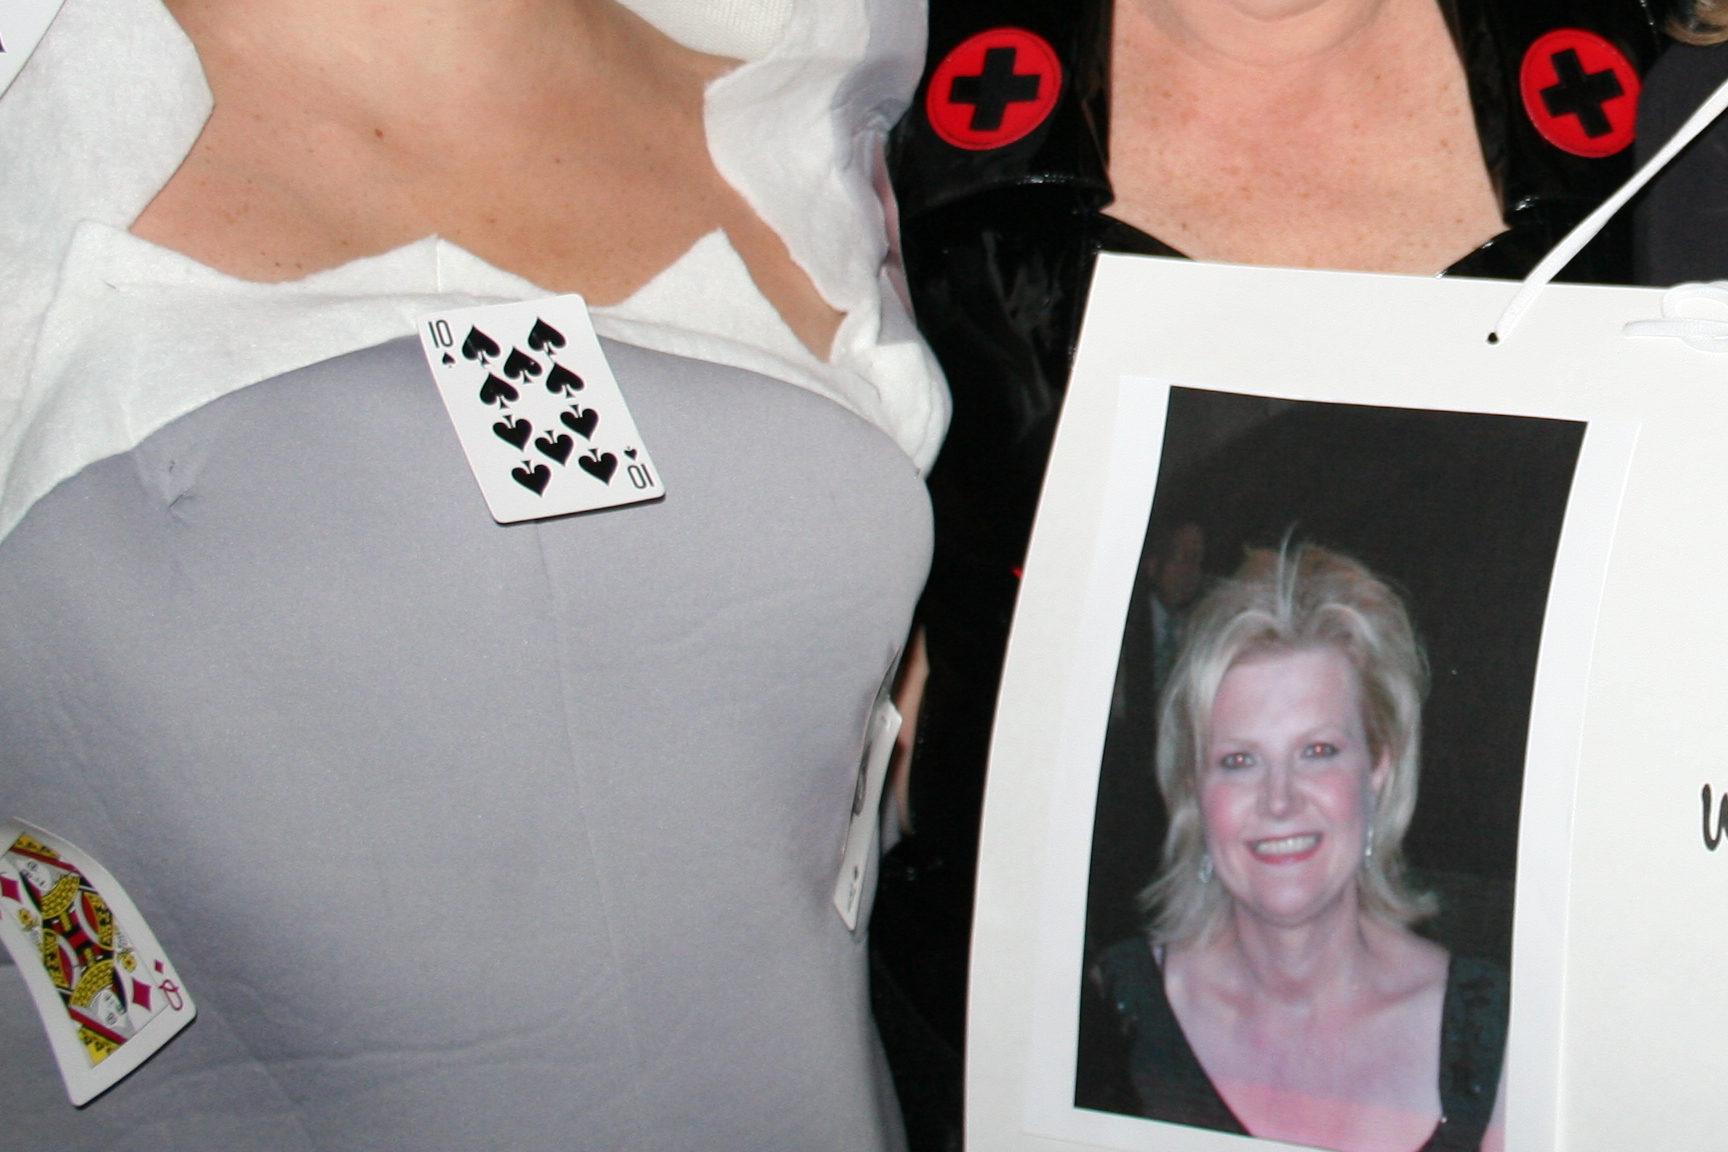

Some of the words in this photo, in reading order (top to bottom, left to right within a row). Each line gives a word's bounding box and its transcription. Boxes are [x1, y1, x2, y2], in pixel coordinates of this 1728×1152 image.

[428, 319, 454, 349] 10
[627, 463, 655, 489] 10
[158, 979, 183, 1011] Q
